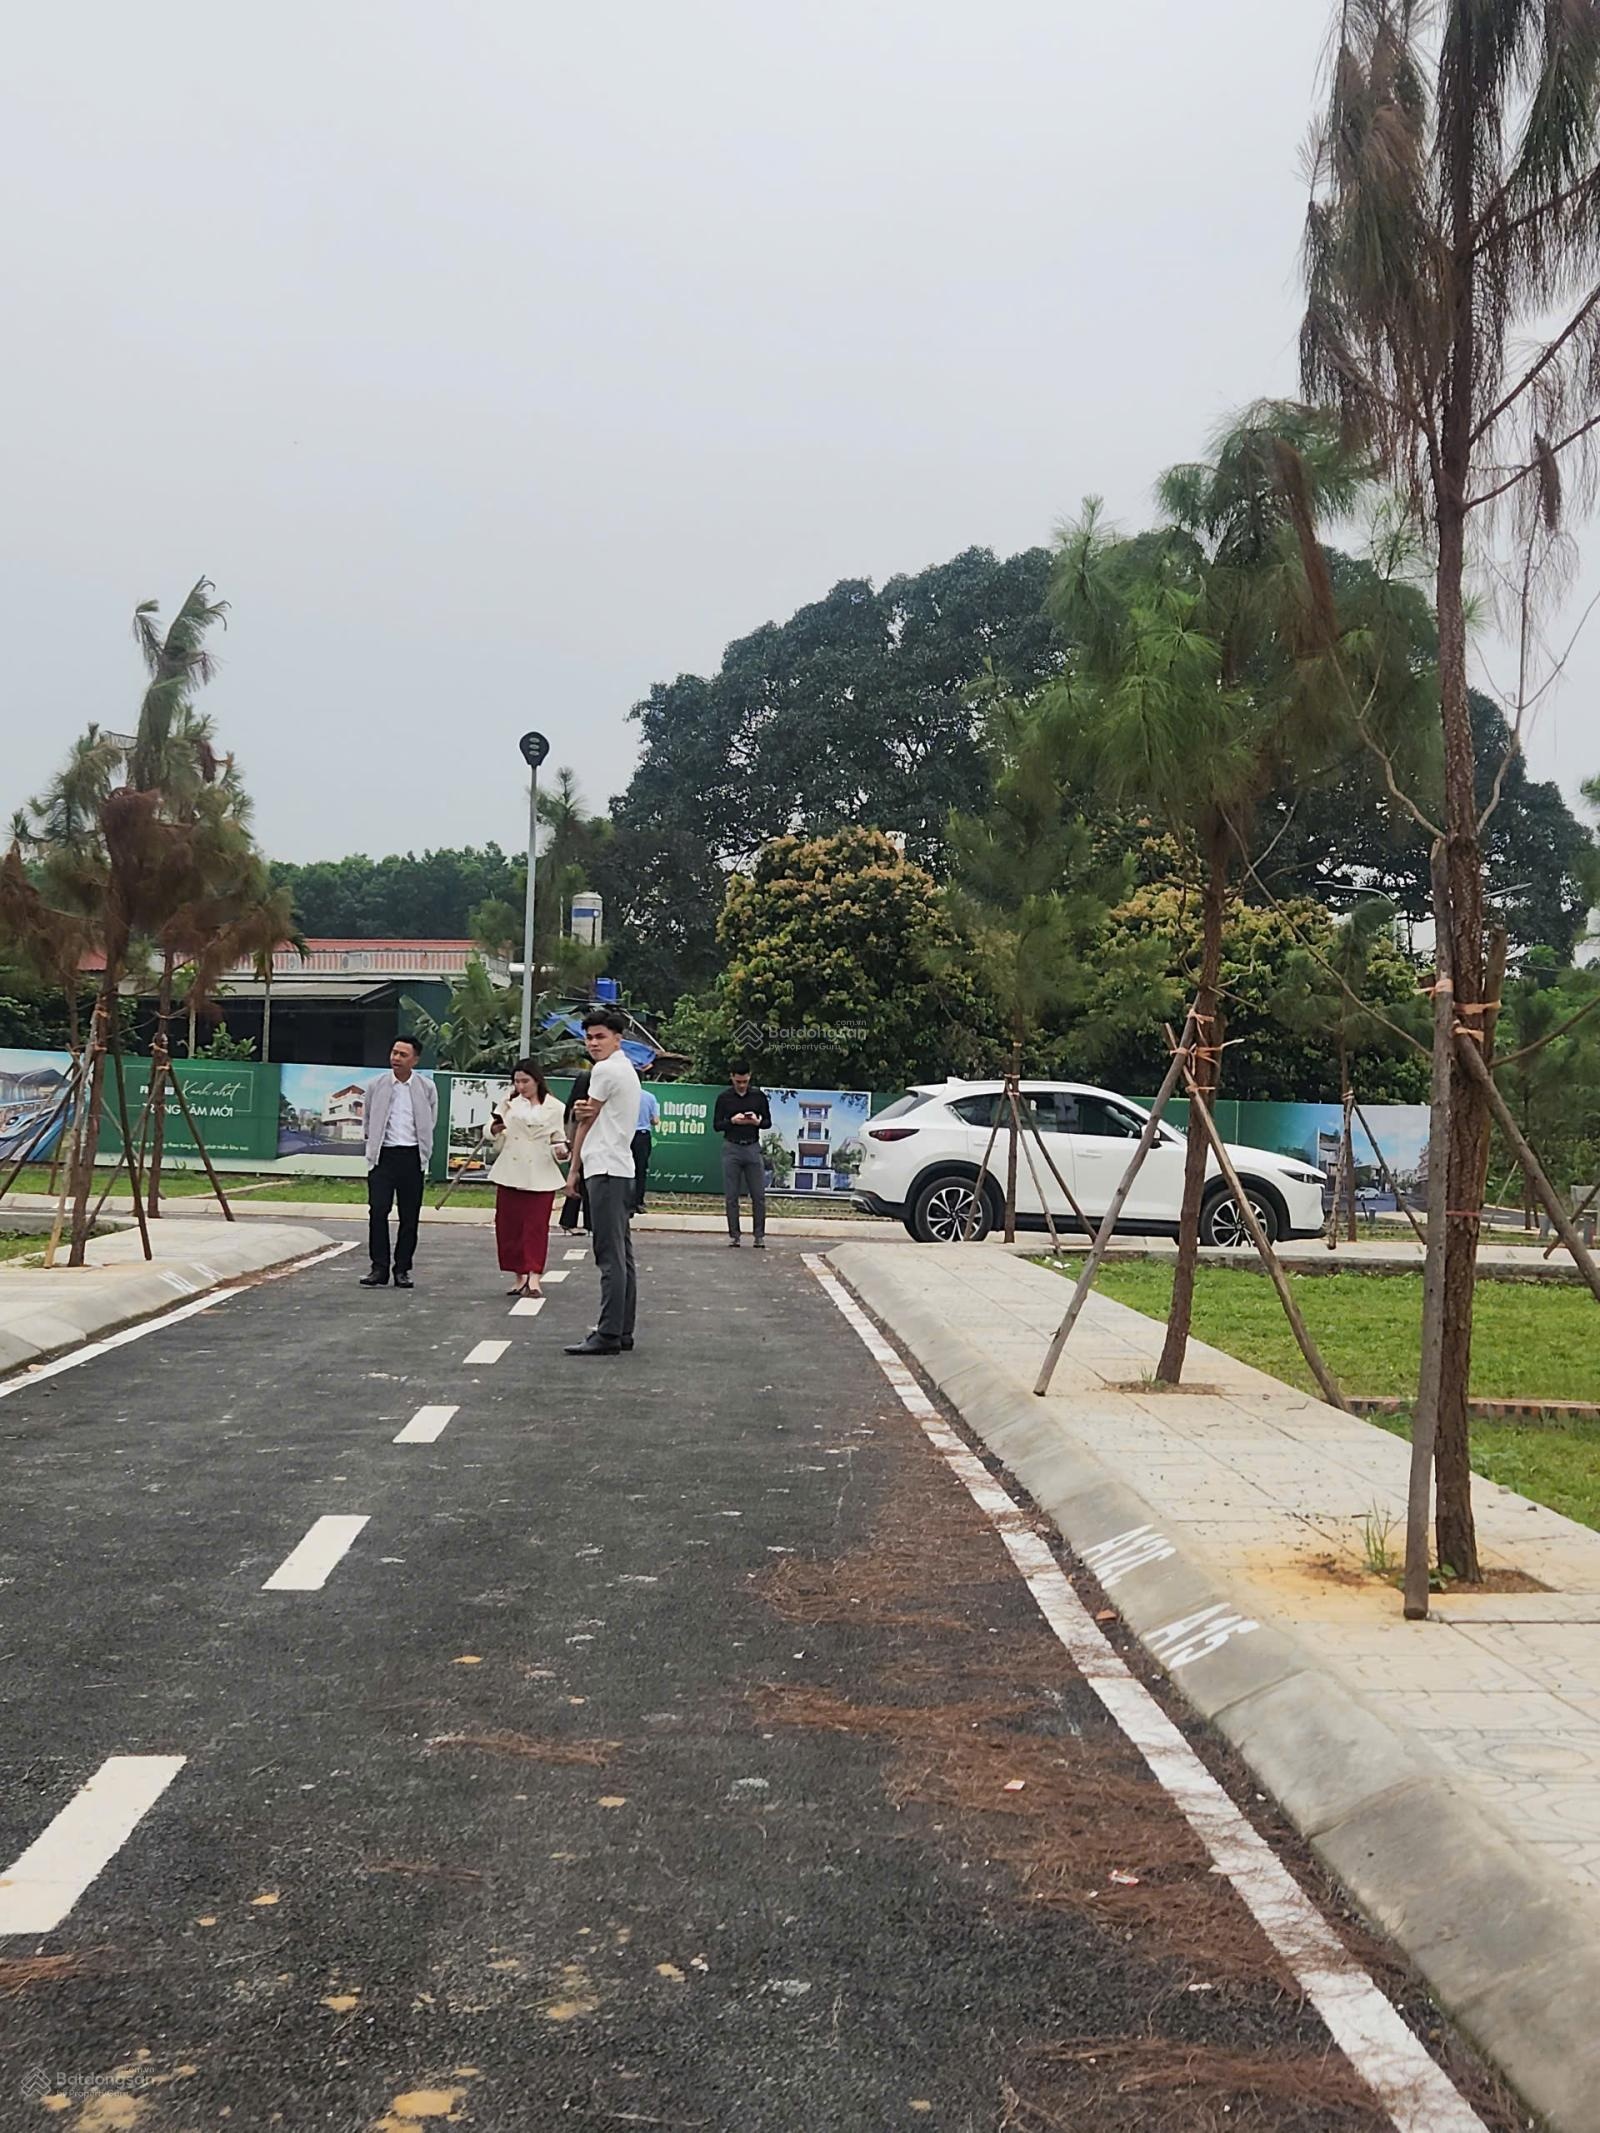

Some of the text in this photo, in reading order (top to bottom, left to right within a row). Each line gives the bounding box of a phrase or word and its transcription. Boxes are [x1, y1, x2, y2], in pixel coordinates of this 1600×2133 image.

[663, 1101, 707, 1119] thượng
[680, 1119, 705, 1135] tròn
[1143, 1602, 1260, 1671] A15
